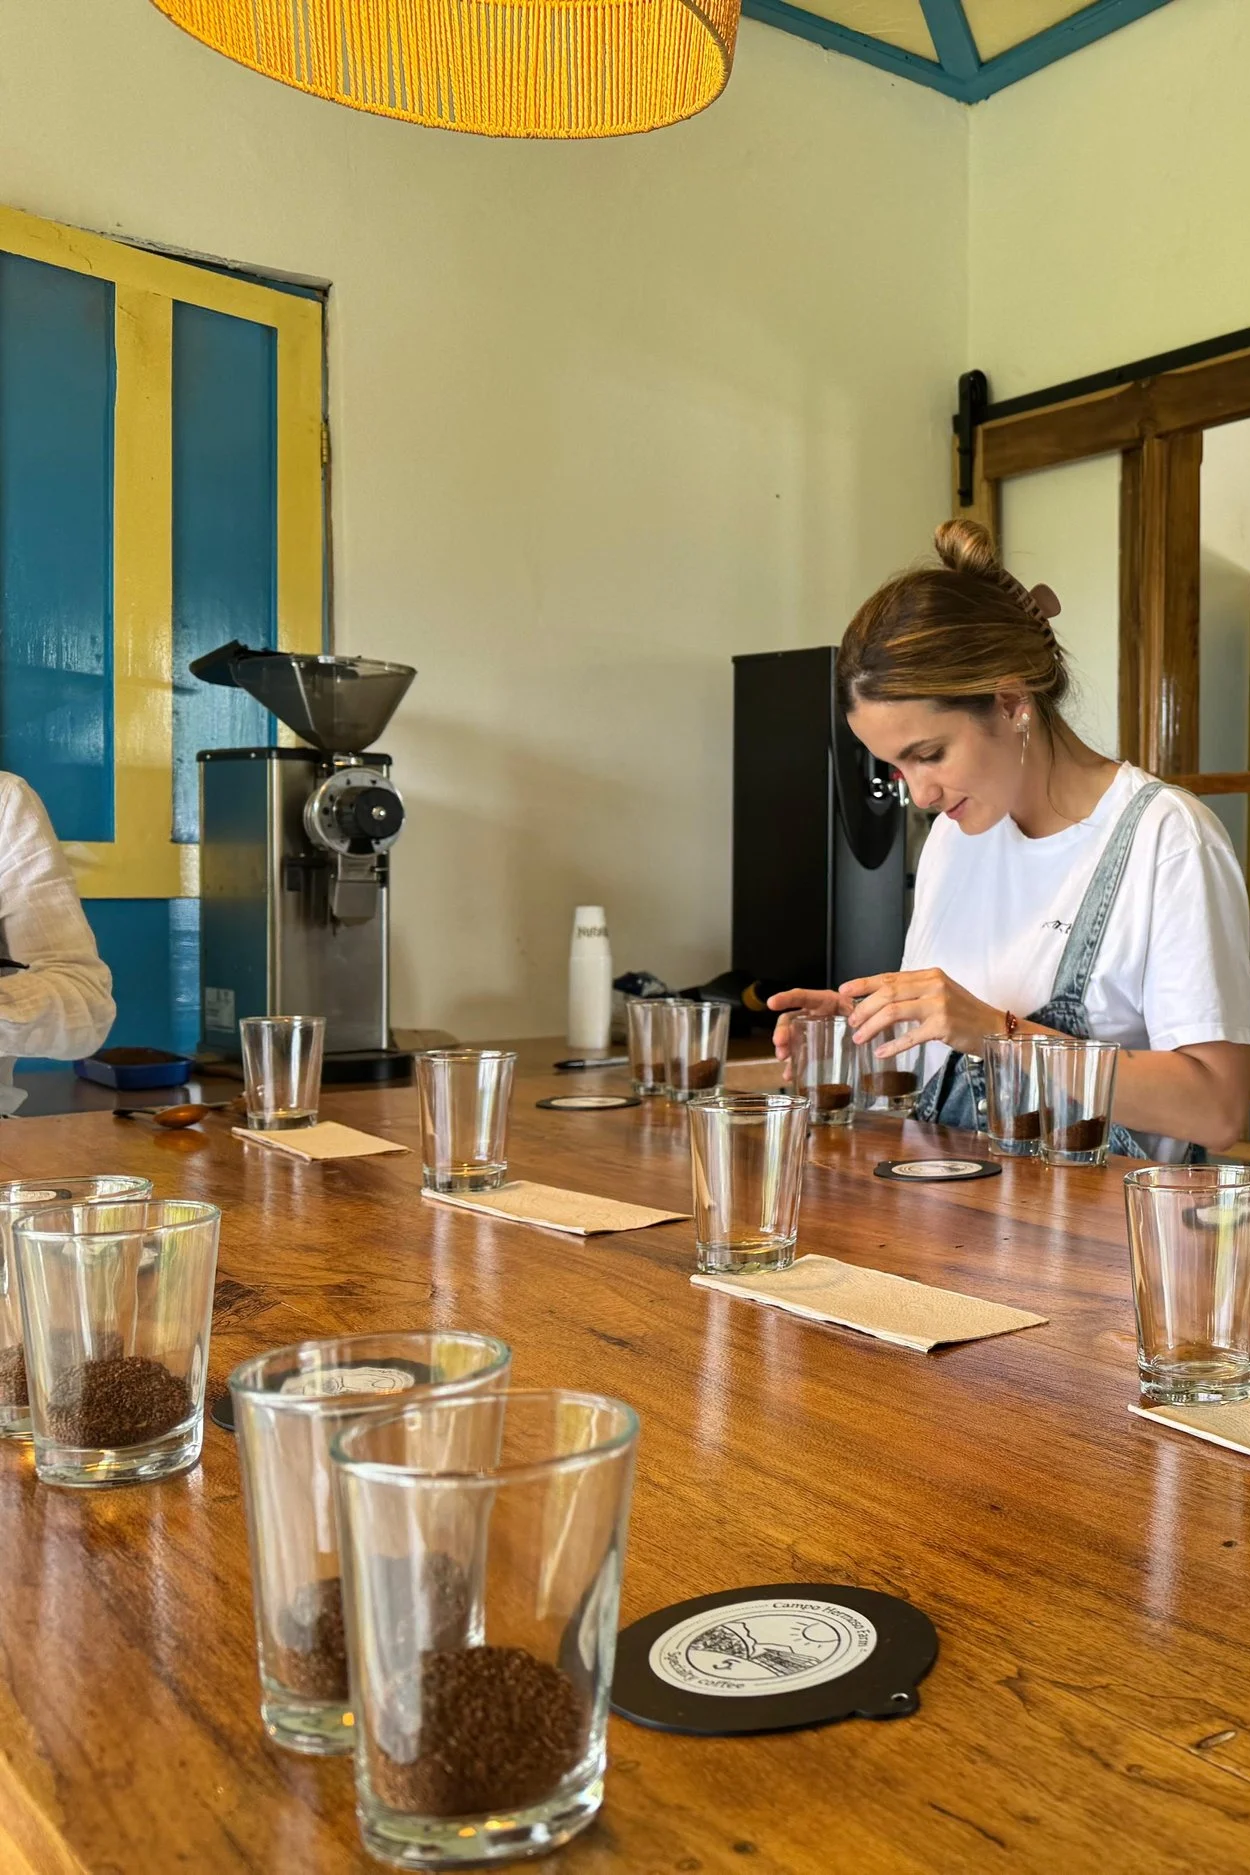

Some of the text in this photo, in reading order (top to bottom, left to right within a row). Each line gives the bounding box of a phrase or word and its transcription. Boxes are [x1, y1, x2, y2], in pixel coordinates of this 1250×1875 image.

[772, 1602, 871, 1648] Campo Hermoso Farm
[664, 1651, 745, 1689] Specialty coffee
